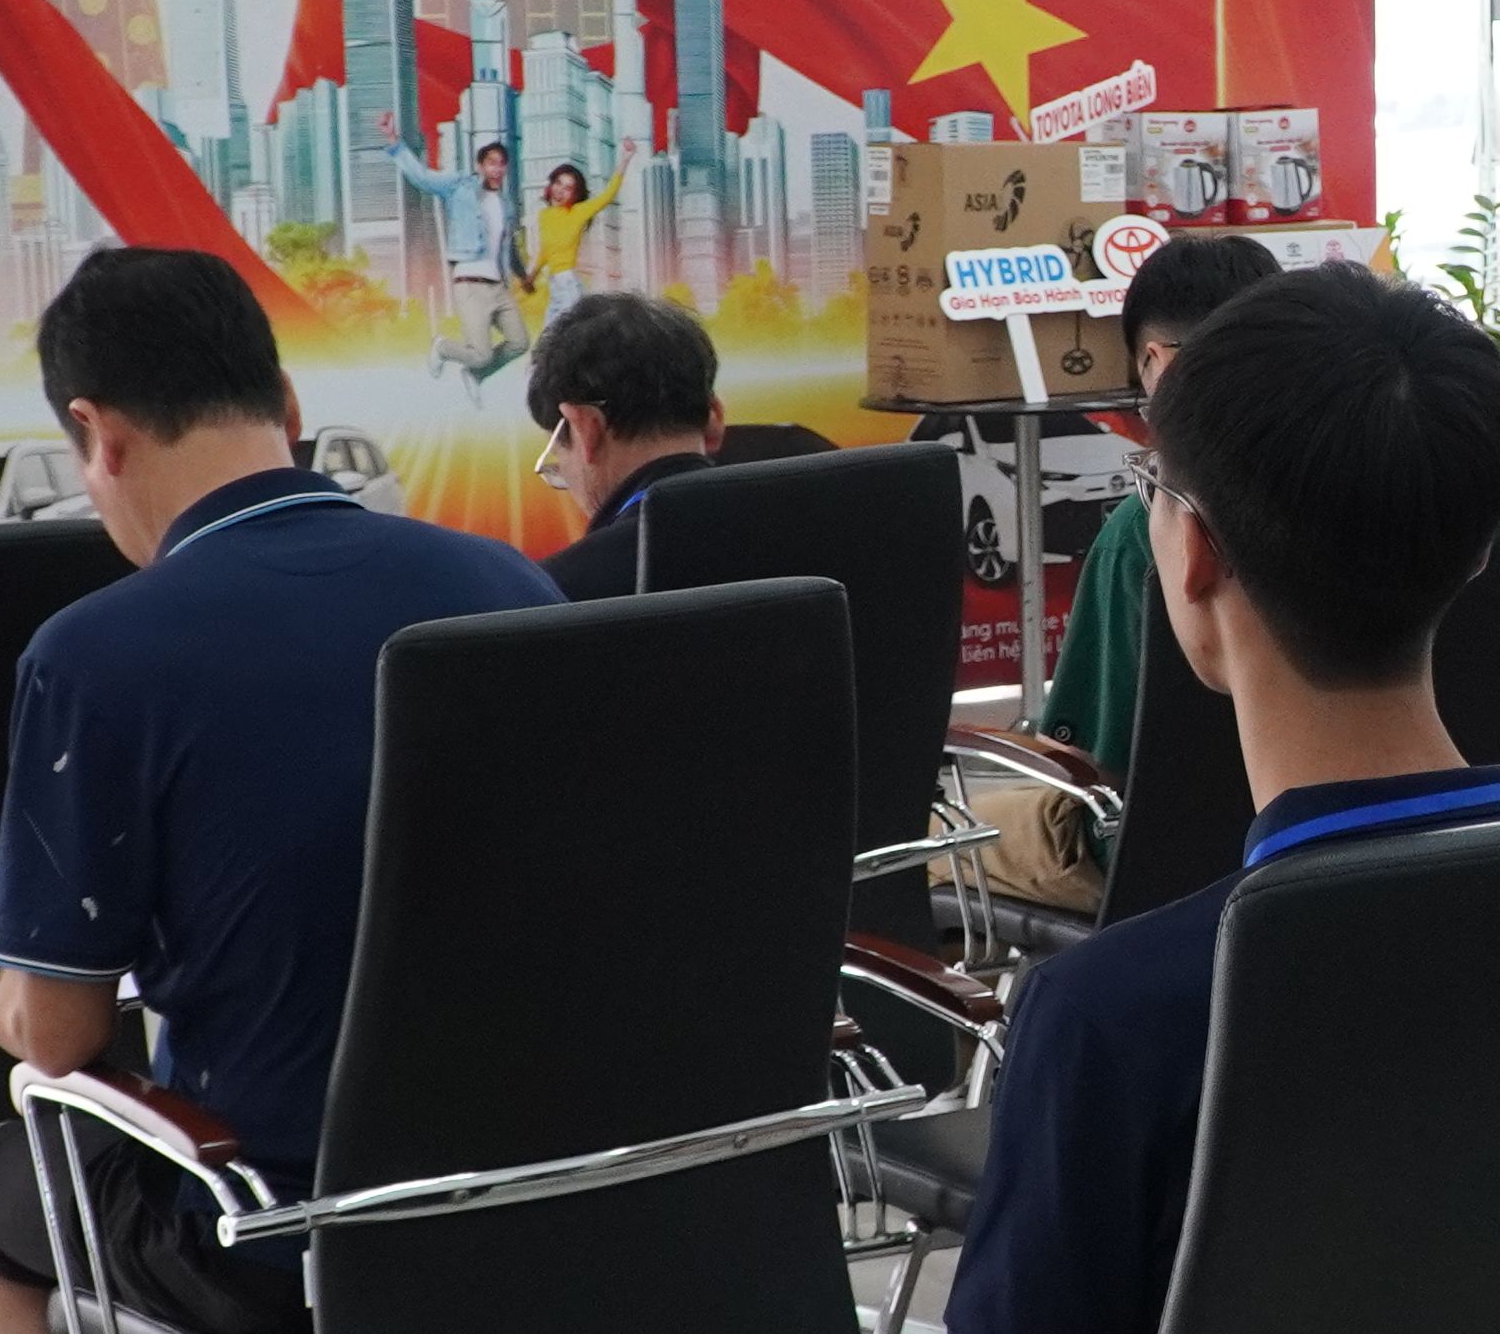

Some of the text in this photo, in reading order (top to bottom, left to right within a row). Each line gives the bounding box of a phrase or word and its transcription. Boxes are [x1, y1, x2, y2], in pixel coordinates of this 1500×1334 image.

[1036, 99, 1084, 141] TOYOTA
[1088, 84, 1122, 120] LONG
[964, 193, 998, 212] ASIA
[955, 254, 1064, 288] HYBRID
[951, 296, 976, 310] Gia
[981, 294, 1009, 310] Hạn
[1043, 287, 1082, 301] Hành
